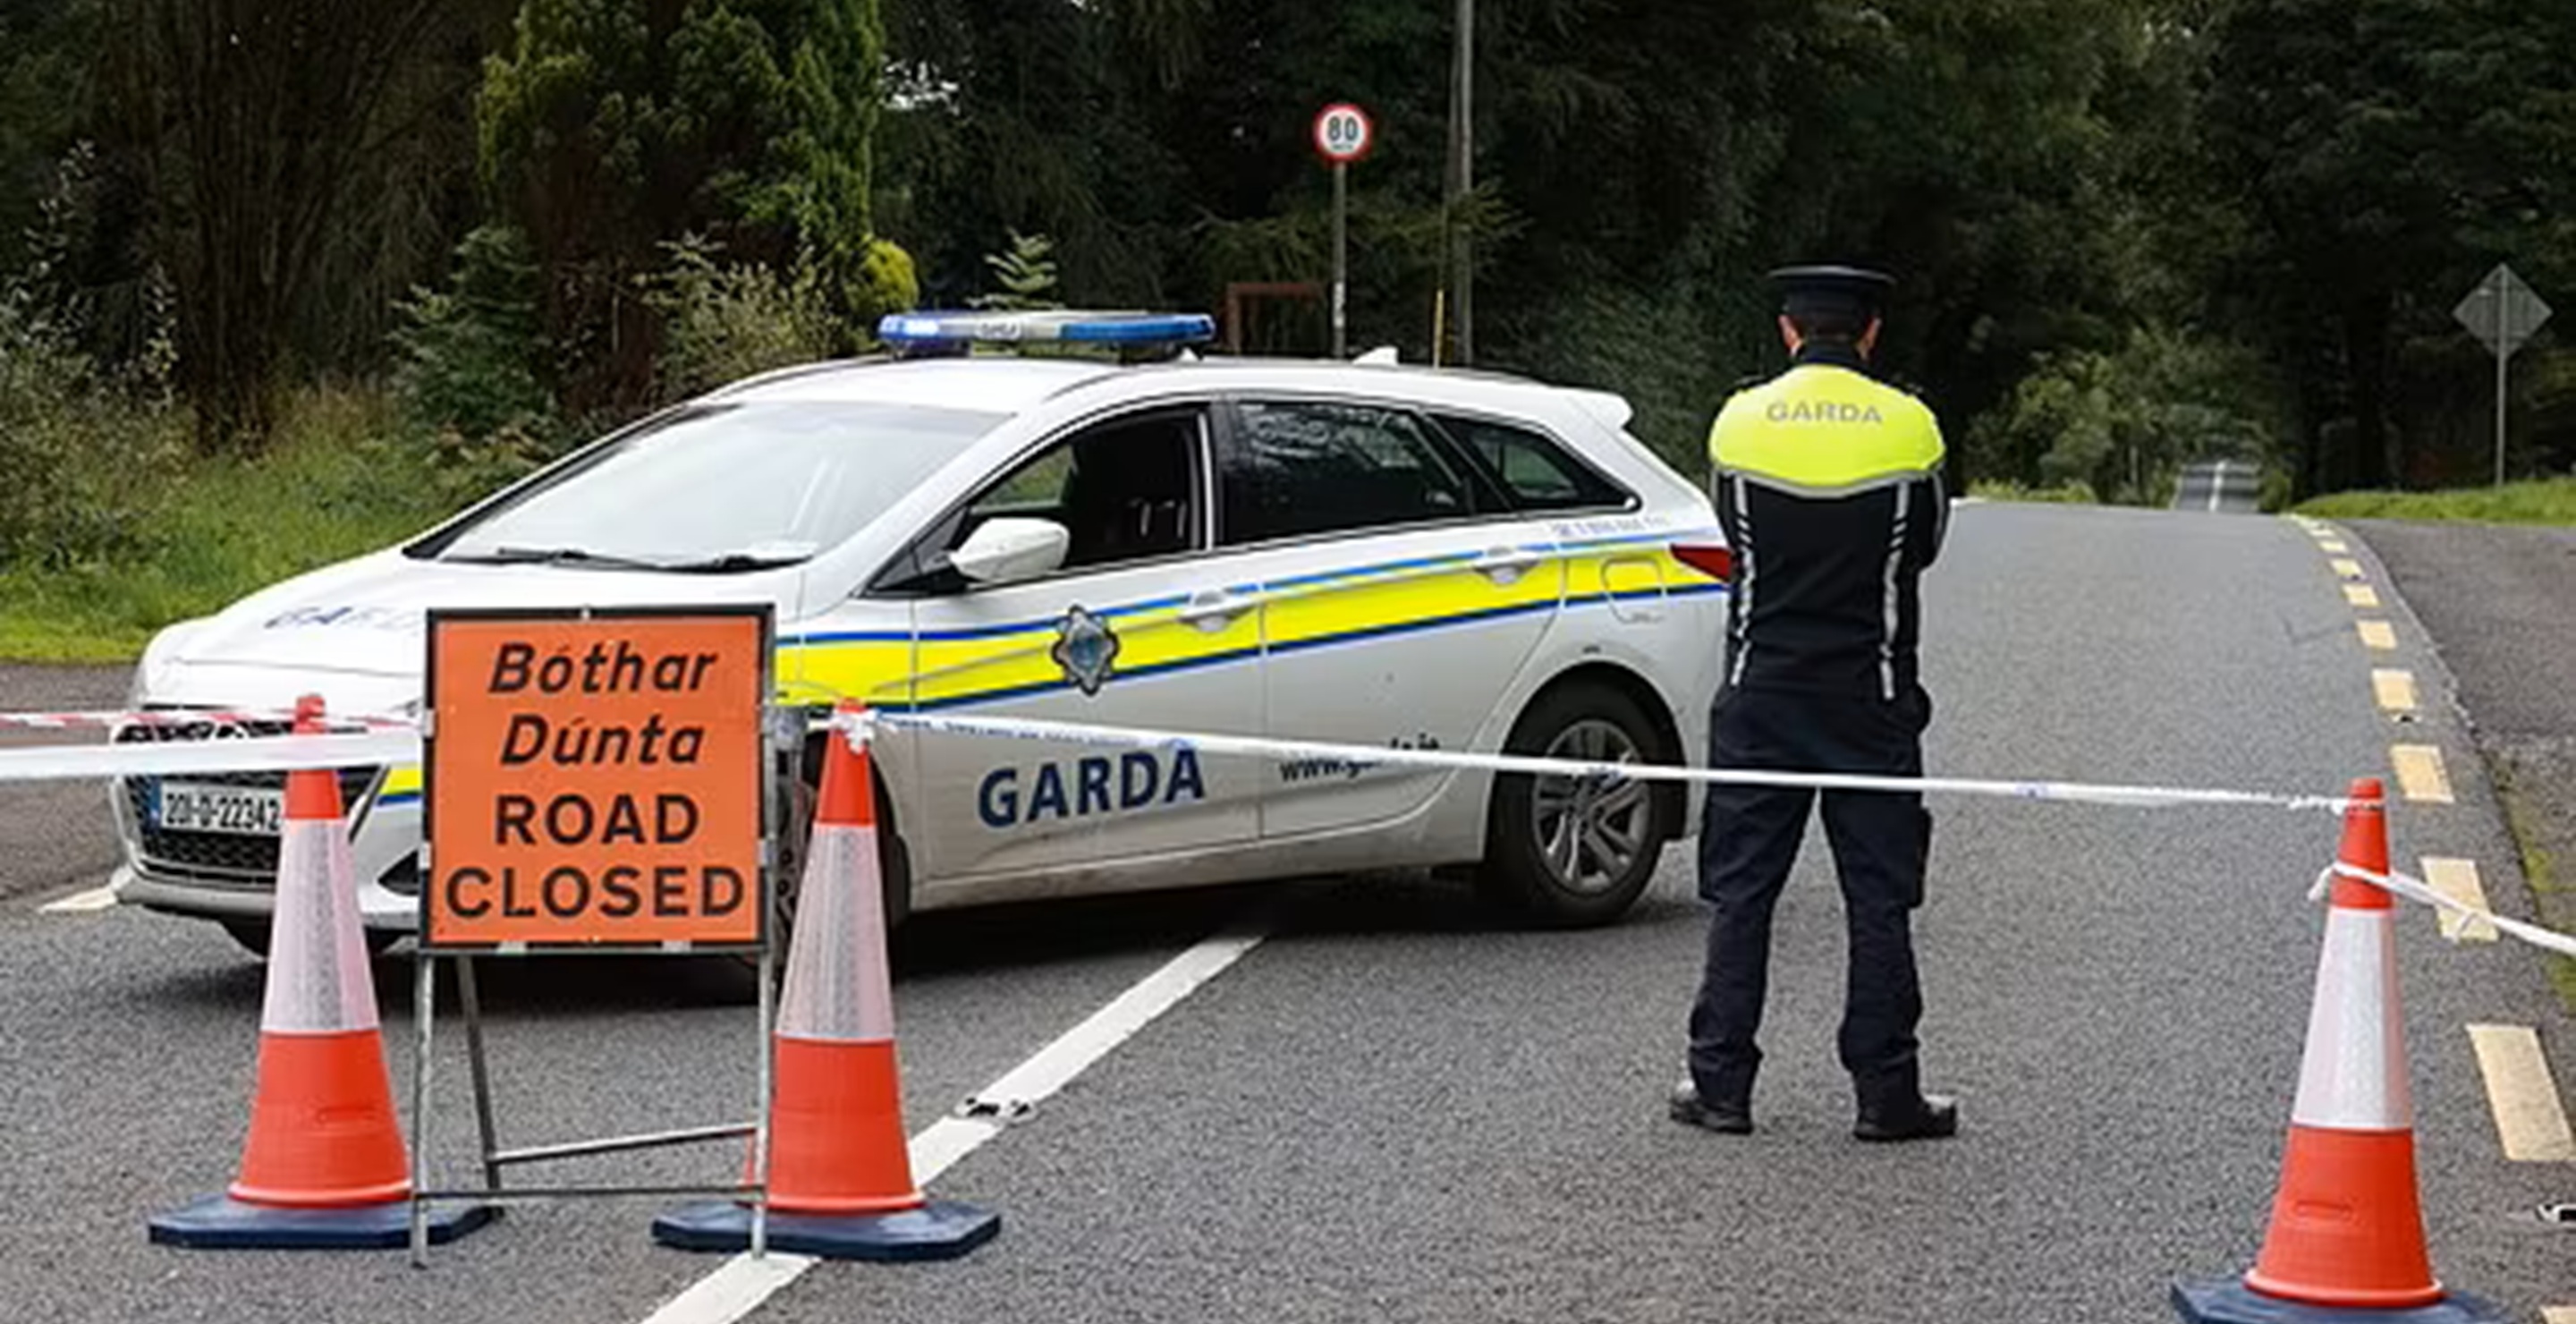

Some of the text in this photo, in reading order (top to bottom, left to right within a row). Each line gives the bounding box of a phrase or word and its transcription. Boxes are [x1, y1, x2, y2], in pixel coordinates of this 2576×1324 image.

[1327, 116, 1359, 141] 80
[1767, 401, 1882, 423] GARDA
[488, 641, 718, 693] Bóthar
[500, 714, 705, 764] Dúnta
[978, 749, 1205, 828] GARDA
[496, 794, 699, 844] ROAD
[446, 866, 745, 917] CLOSED
